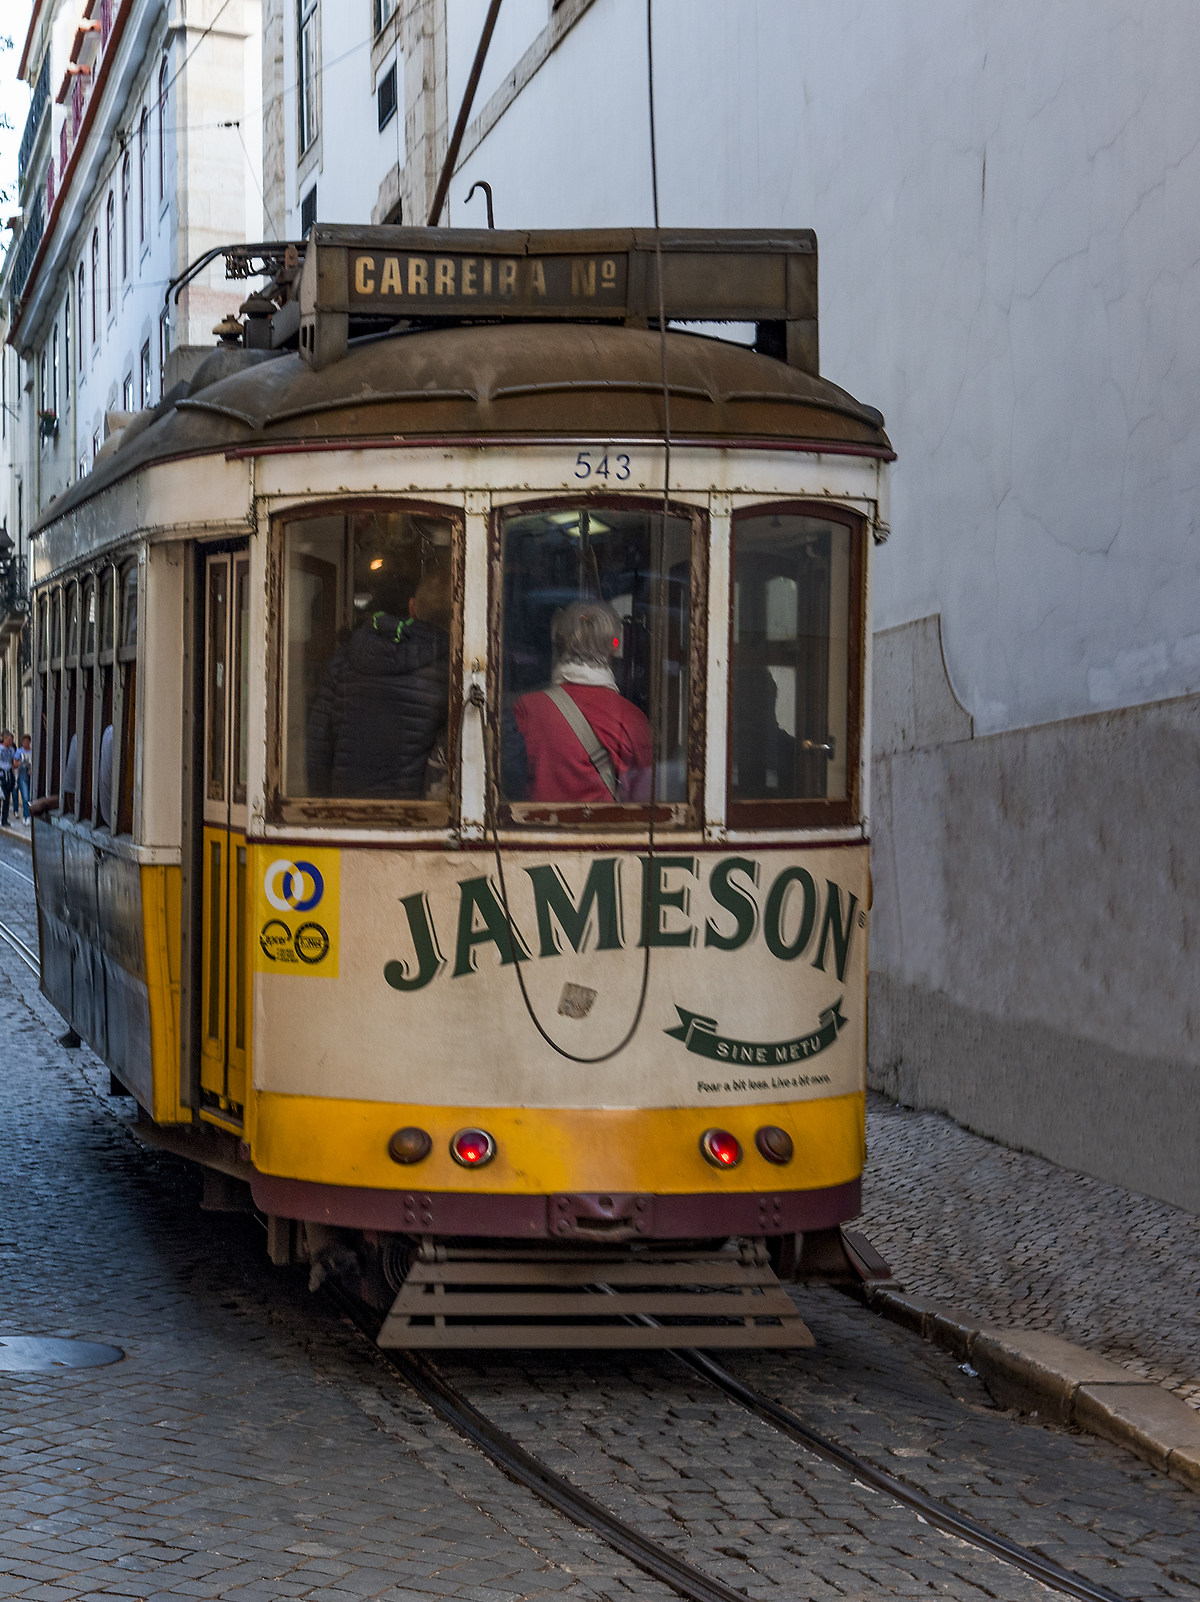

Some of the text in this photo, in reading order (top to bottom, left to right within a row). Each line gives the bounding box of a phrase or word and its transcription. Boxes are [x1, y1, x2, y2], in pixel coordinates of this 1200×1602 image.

[355, 256, 547, 296] CARREIRA
[574, 452, 631, 480] 543
[383, 856, 859, 992] JAMESON
[716, 1035, 821, 1064] SINE METU
[732, 1079, 747, 1092] bit
